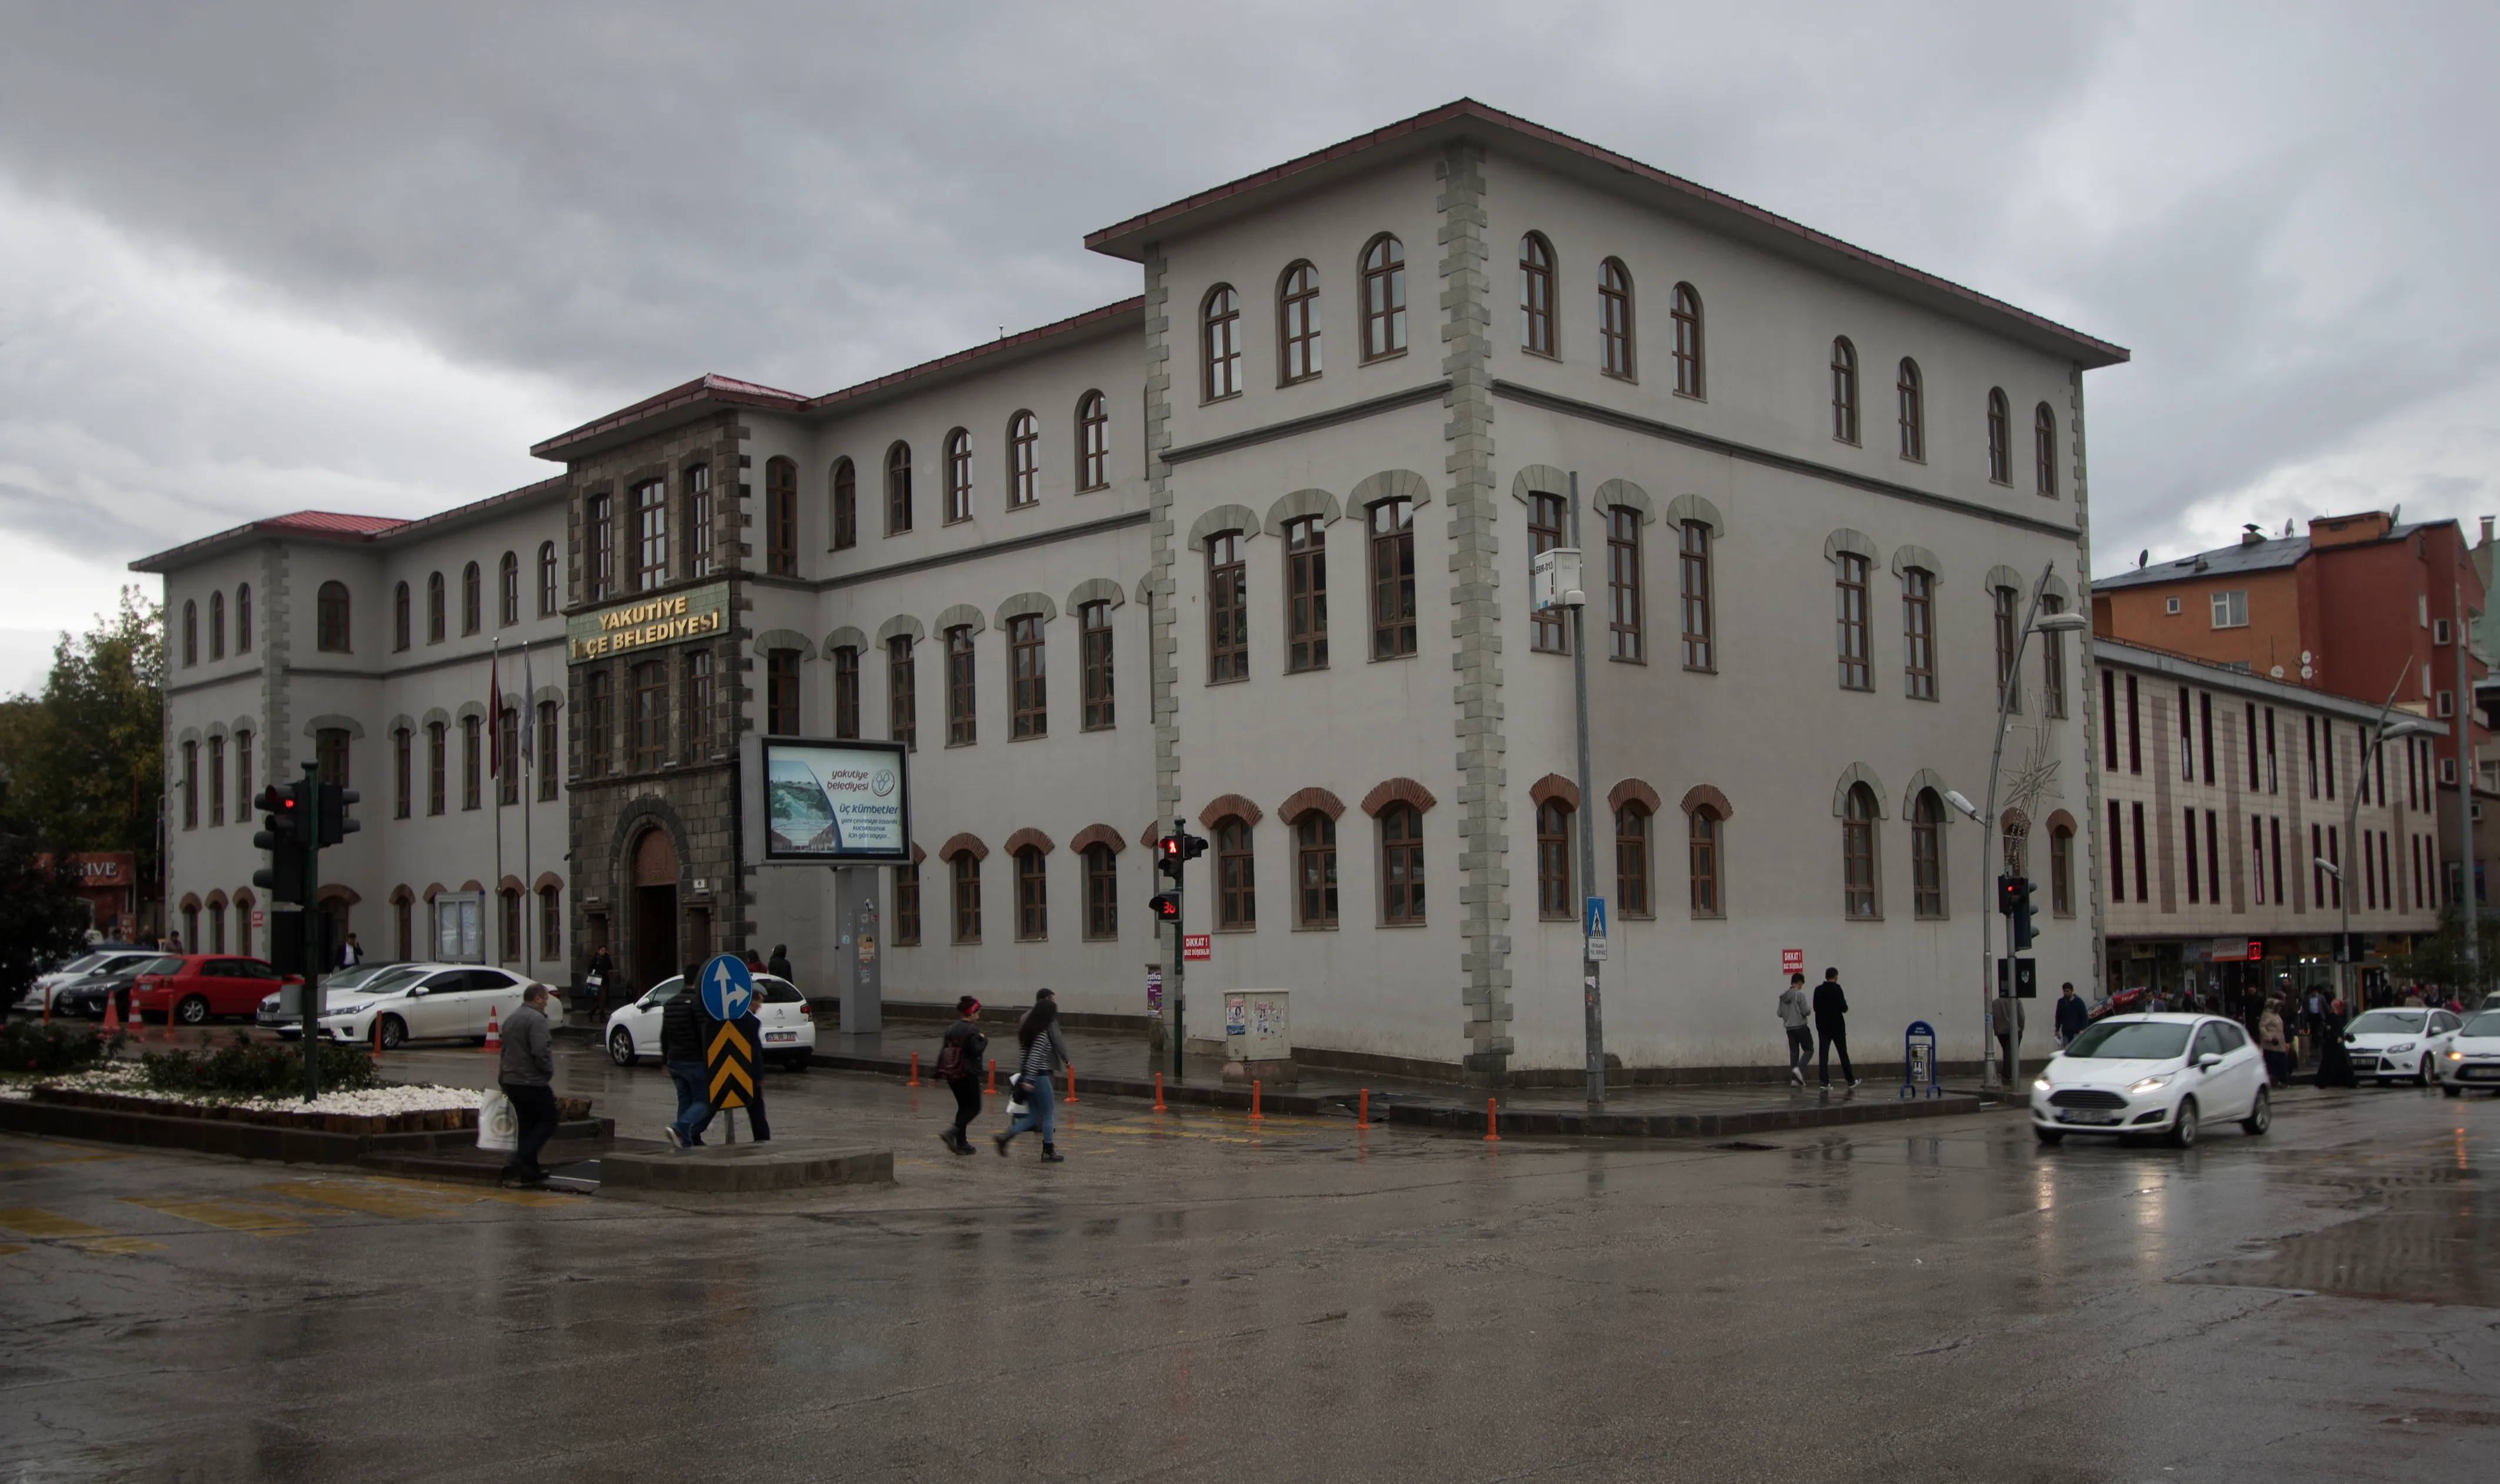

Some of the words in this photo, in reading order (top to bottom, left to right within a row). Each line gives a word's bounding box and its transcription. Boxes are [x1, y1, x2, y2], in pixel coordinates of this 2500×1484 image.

[1536, 561, 1553, 574] ERR-013
[599, 596, 686, 630] YAKUTİYE
[614, 608, 718, 649] BELEDİYESİ
[832, 770, 868, 781] yakutiye
[827, 781, 869, 792] belediyesi
[839, 804, 851, 815] üç
[852, 804, 899, 814] kümbetler
[1186, 938, 1205, 947] DİKKAT
